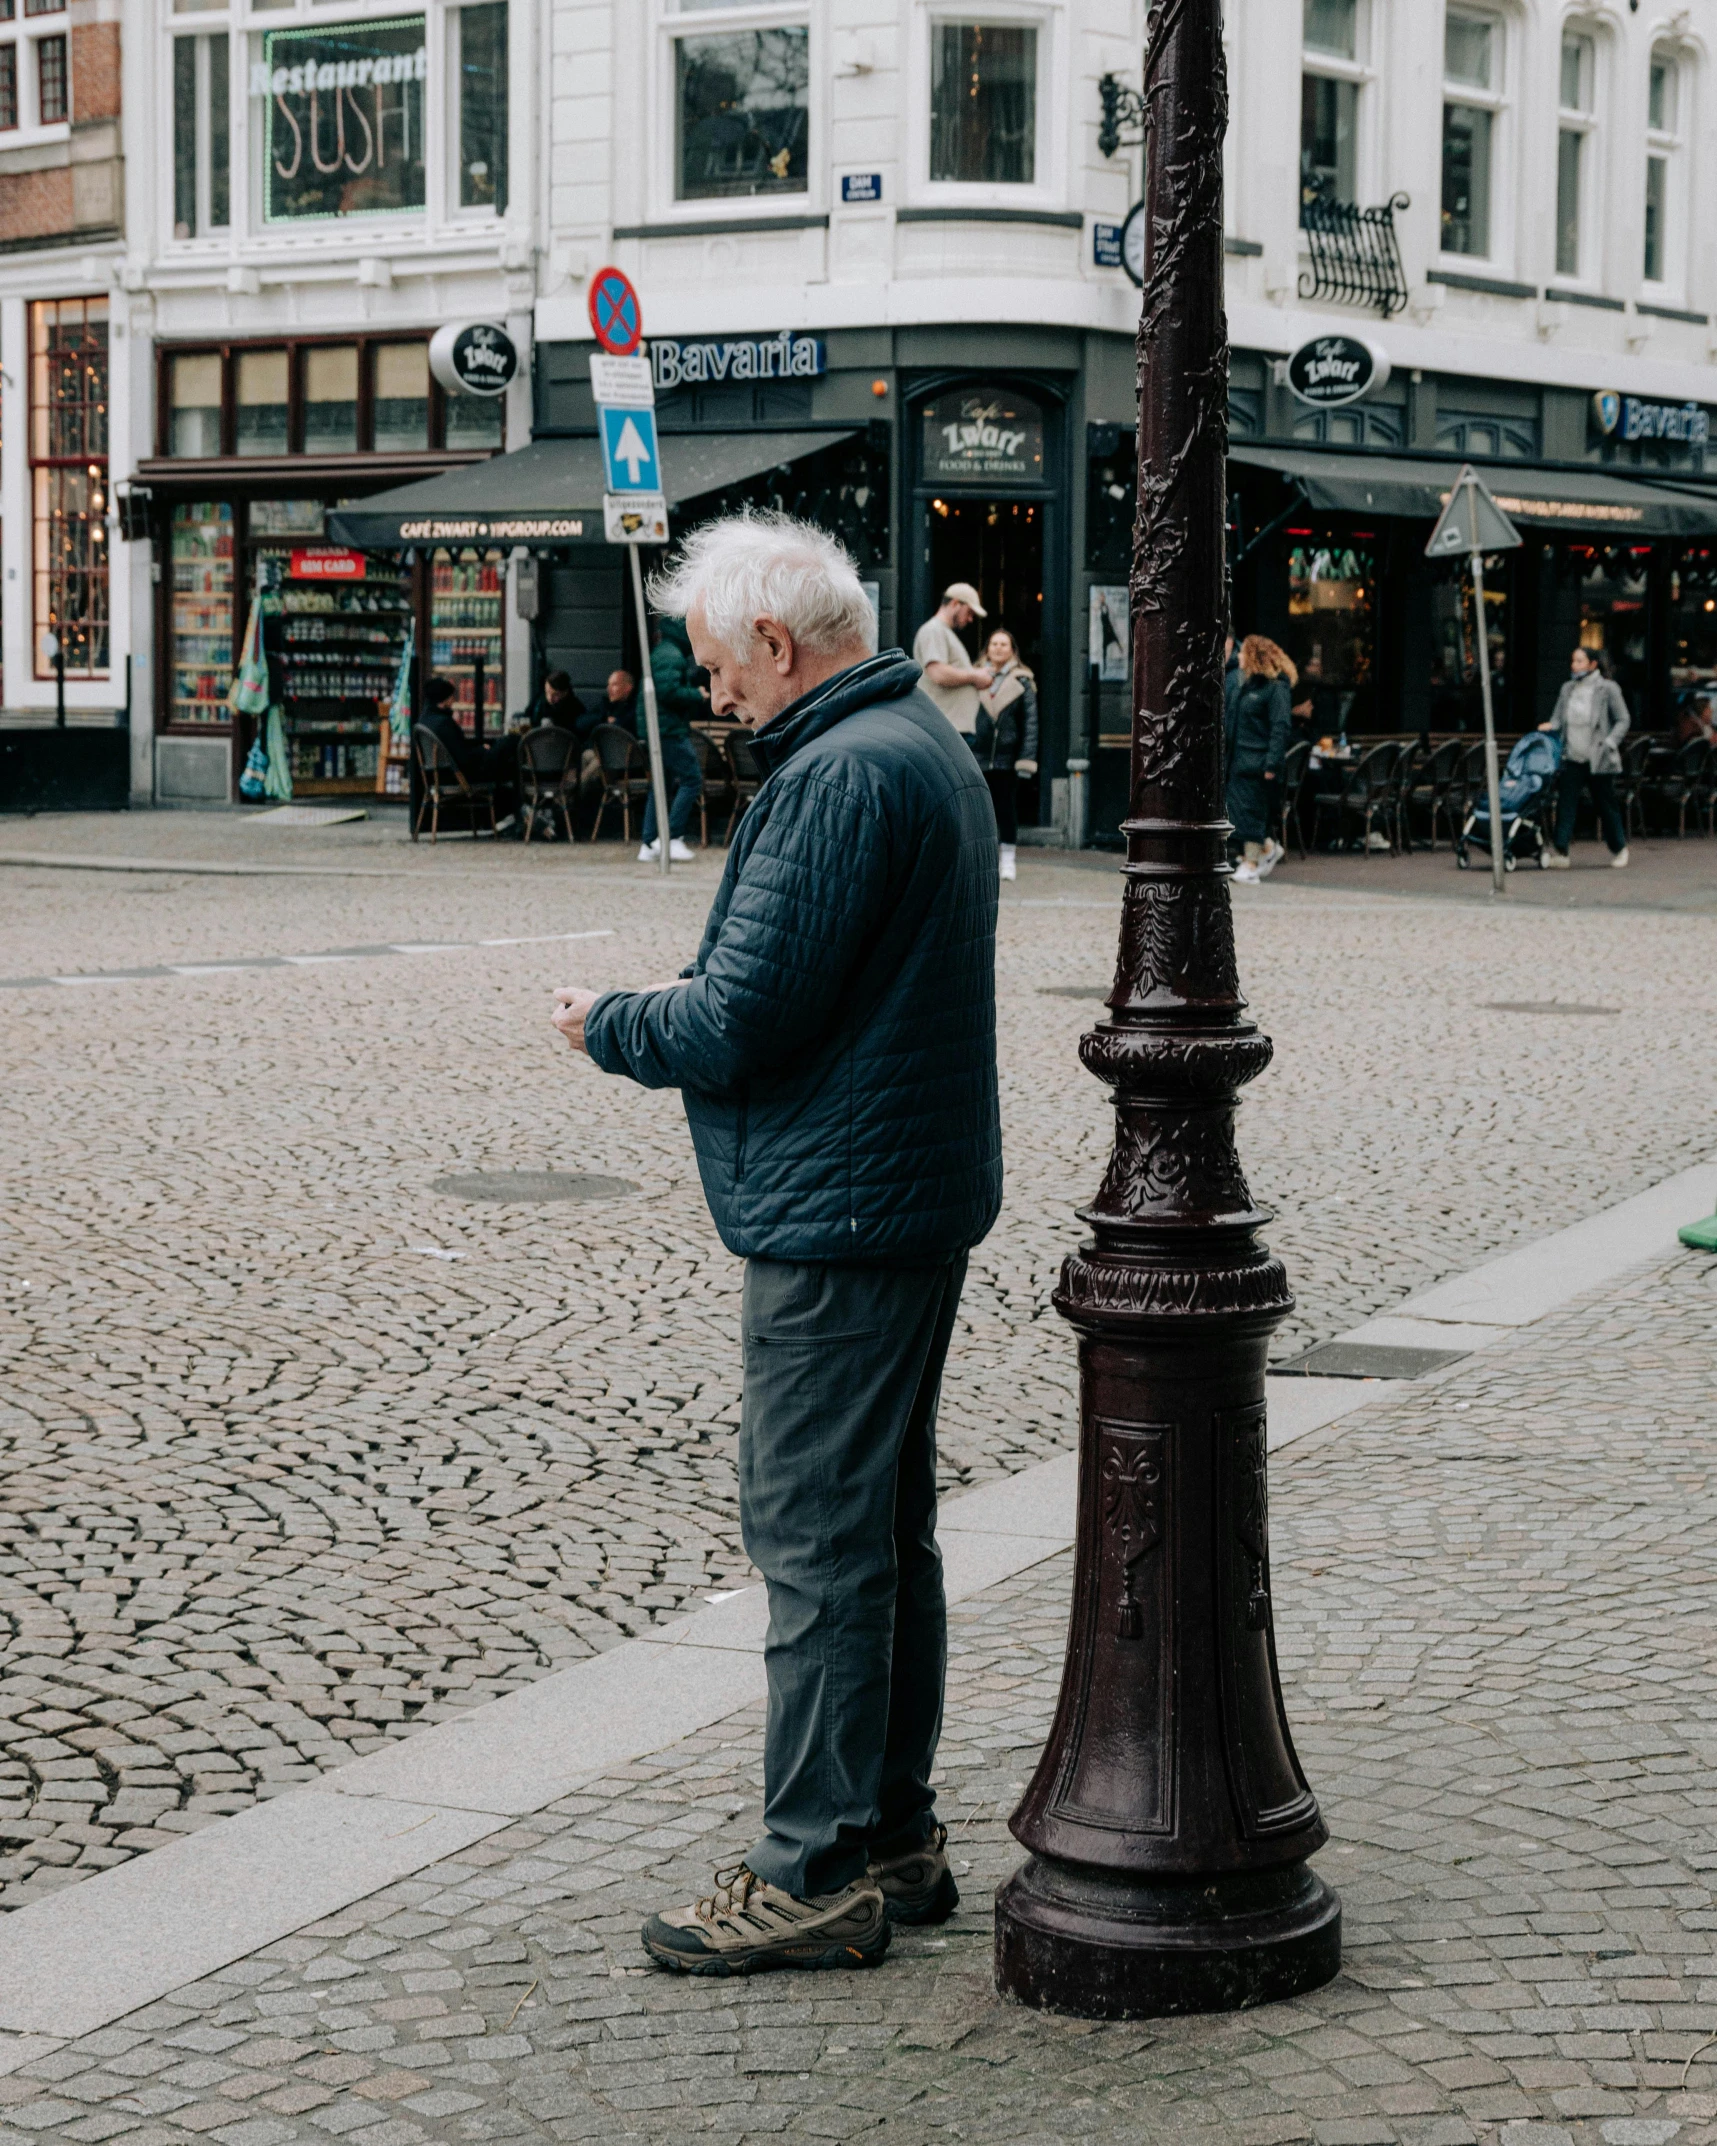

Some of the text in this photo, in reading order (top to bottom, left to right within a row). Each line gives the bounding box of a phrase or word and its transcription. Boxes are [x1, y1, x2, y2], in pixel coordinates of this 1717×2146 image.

[249, 46, 426, 97] Restaurant
[651, 330, 819, 389] Bavaria
[1624, 398, 1709, 443] Bavaria
[939, 459, 972, 472] FOOD
[984, 459, 1026, 472] DRINKS
[400, 519, 431, 539] CAFÉ
[432, 520, 478, 538] ZWART
[301, 559, 356, 574] SIM CARD
